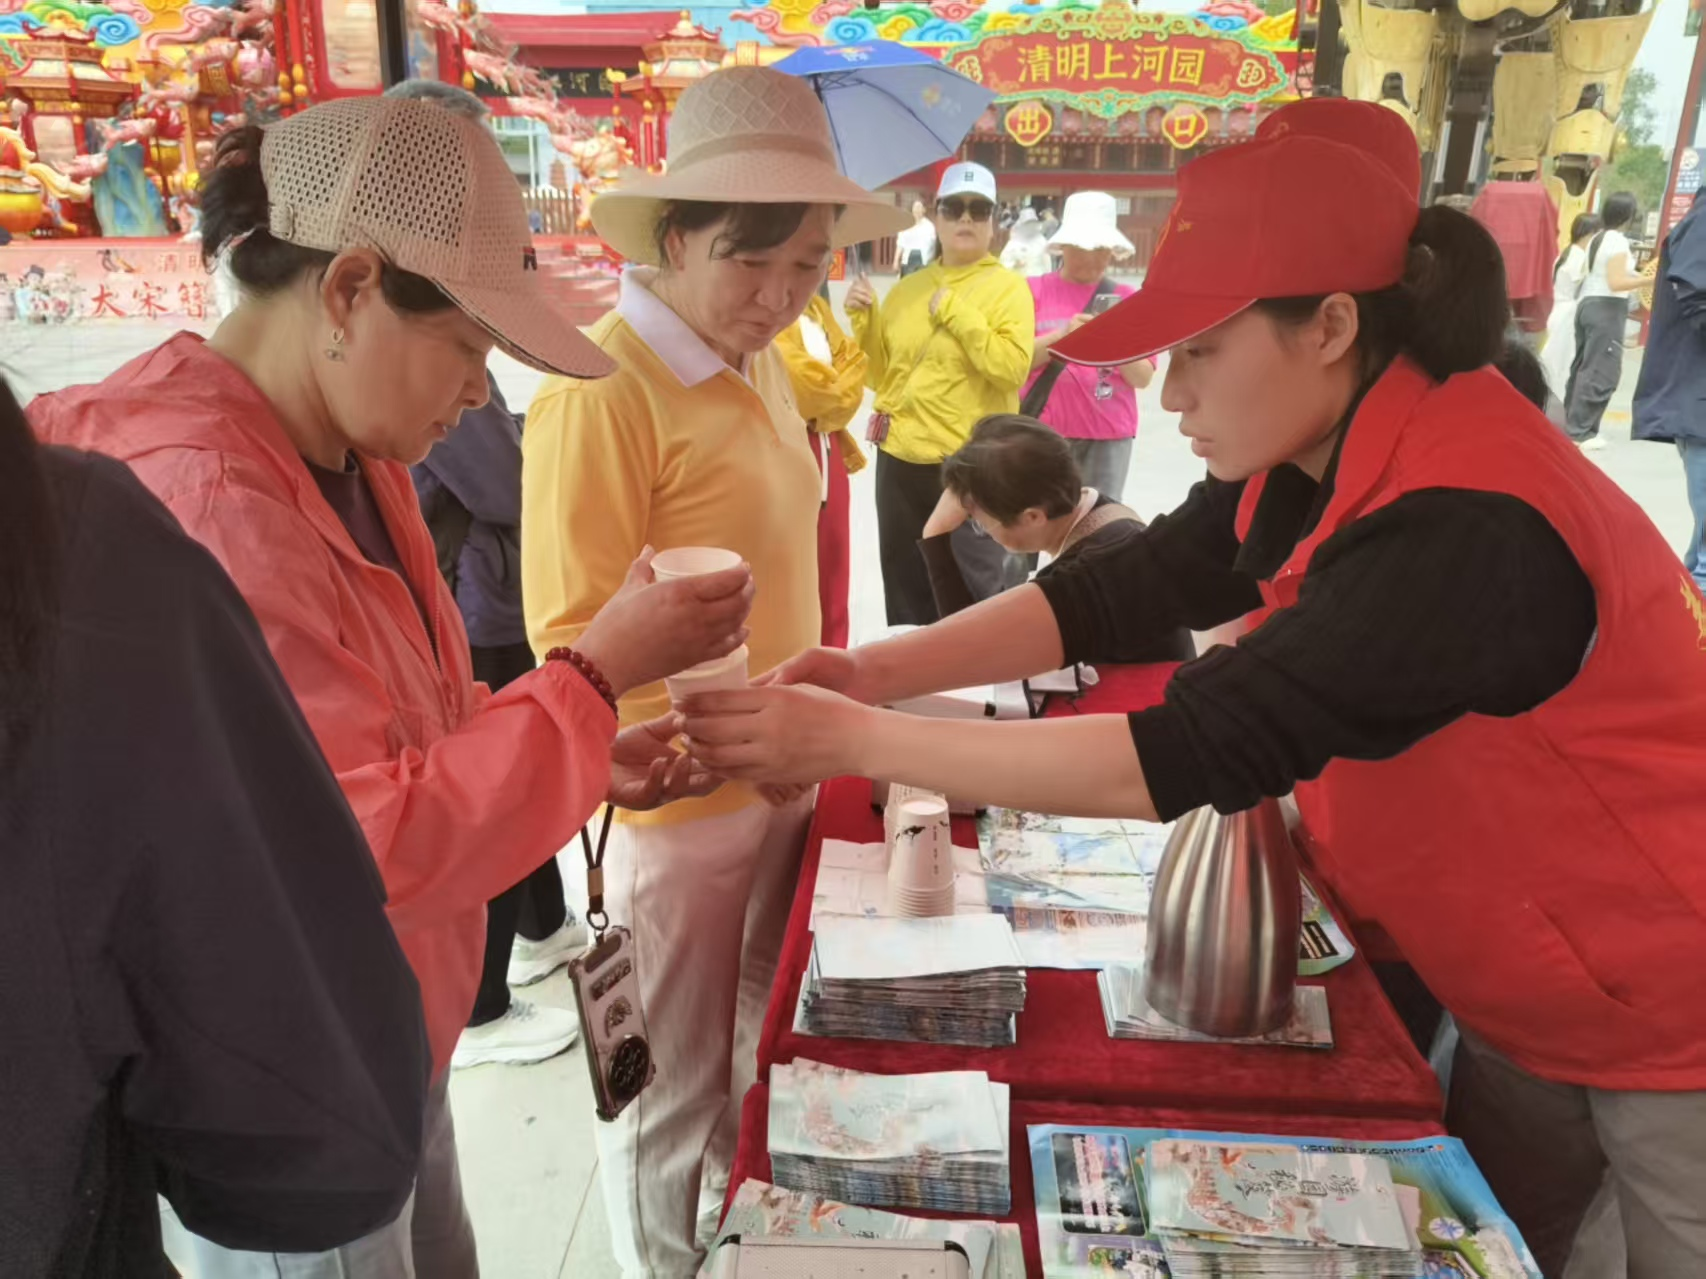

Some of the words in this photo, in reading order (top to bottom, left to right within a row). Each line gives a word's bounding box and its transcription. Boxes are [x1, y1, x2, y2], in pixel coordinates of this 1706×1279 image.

[1017, 42, 1205, 86] 清明上河园
[1017, 108, 1040, 135] 出
[1174, 114, 1197, 137] 口
